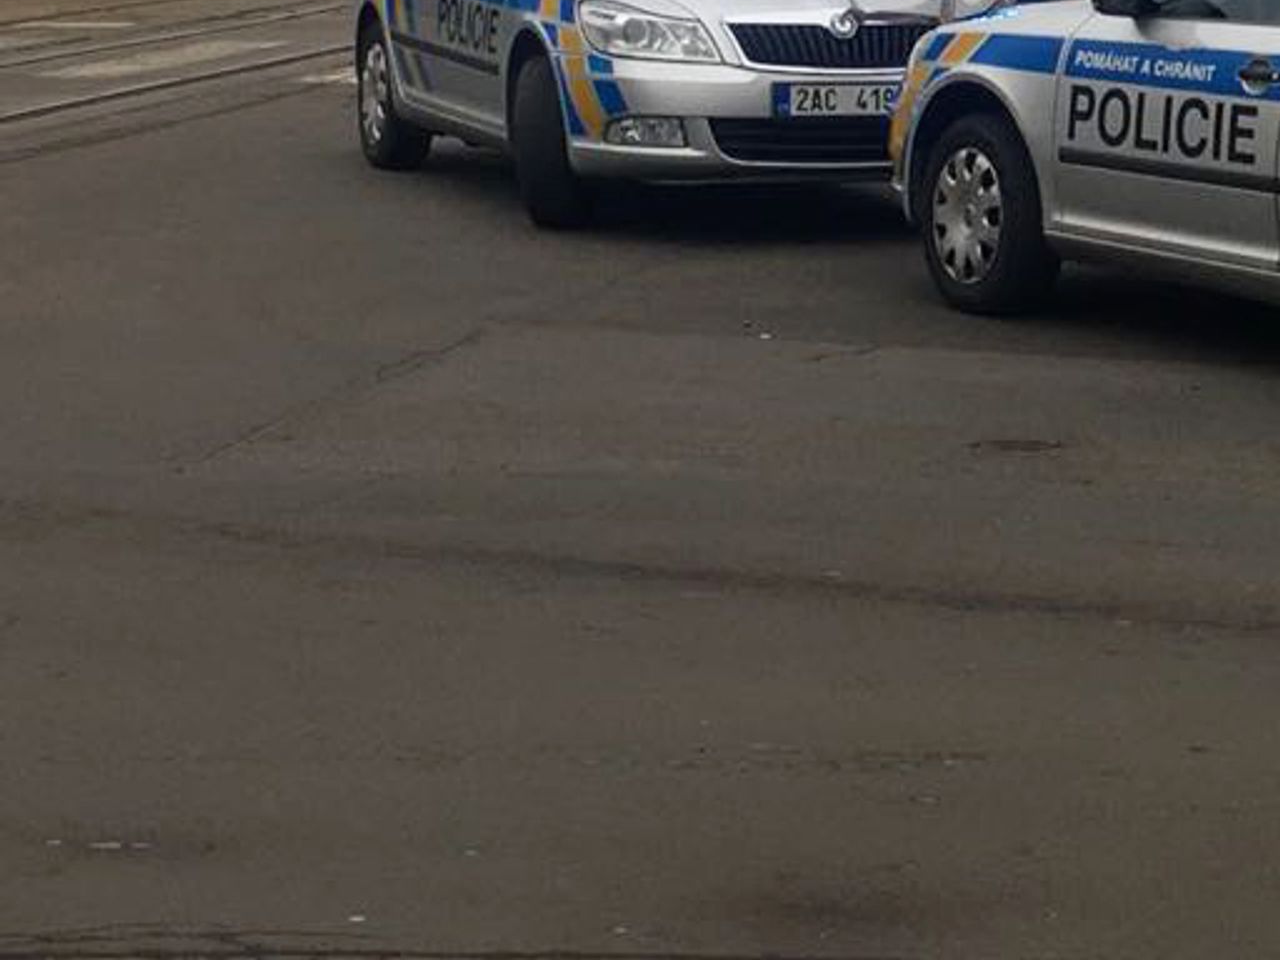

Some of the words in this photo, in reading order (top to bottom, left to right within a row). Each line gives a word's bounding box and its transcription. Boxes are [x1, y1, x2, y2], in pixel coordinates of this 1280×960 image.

[1074, 49, 1138, 73] POMÁHAT
[1140, 60, 1150, 75] A
[1154, 58, 1217, 81] CHRÁNIT
[796, 88, 837, 111] 2AC
[1067, 85, 1259, 164] POLICIE
